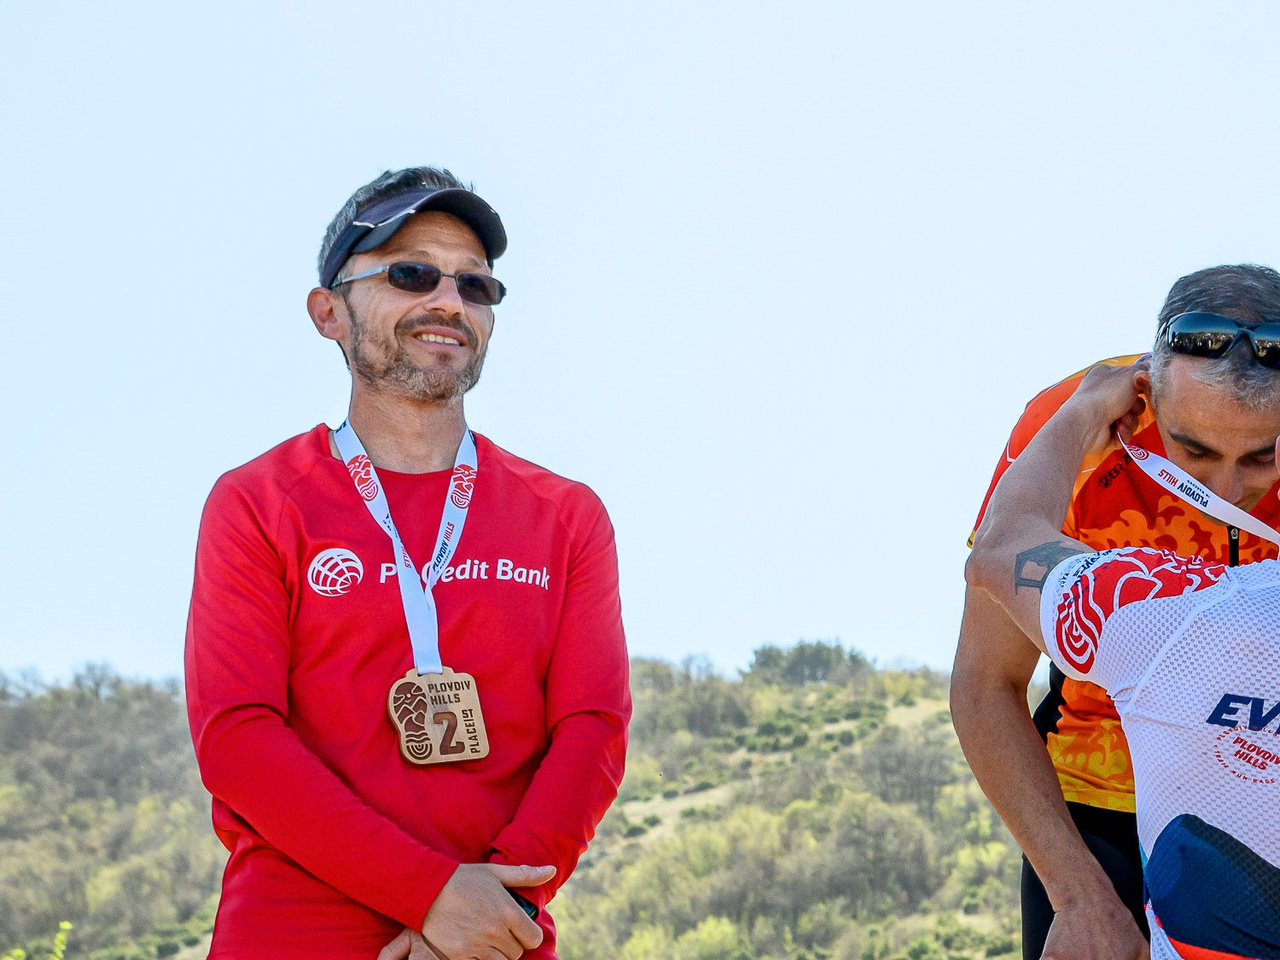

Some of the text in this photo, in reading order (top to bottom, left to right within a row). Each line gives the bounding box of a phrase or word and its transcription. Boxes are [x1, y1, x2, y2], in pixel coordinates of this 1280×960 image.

[1158, 468, 1179, 487] HILLS
[1177, 482, 1209, 508] PLOVDIV
[432, 539, 449, 573] PLOVDIV
[443, 521, 455, 542] HILLS
[495, 558, 551, 591] Bank
[427, 680, 471, 694] PLOVDIV
[430, 693, 461, 706] HILLS
[433, 711, 466, 755] 2
[1233, 749, 1269, 771] HILLS
